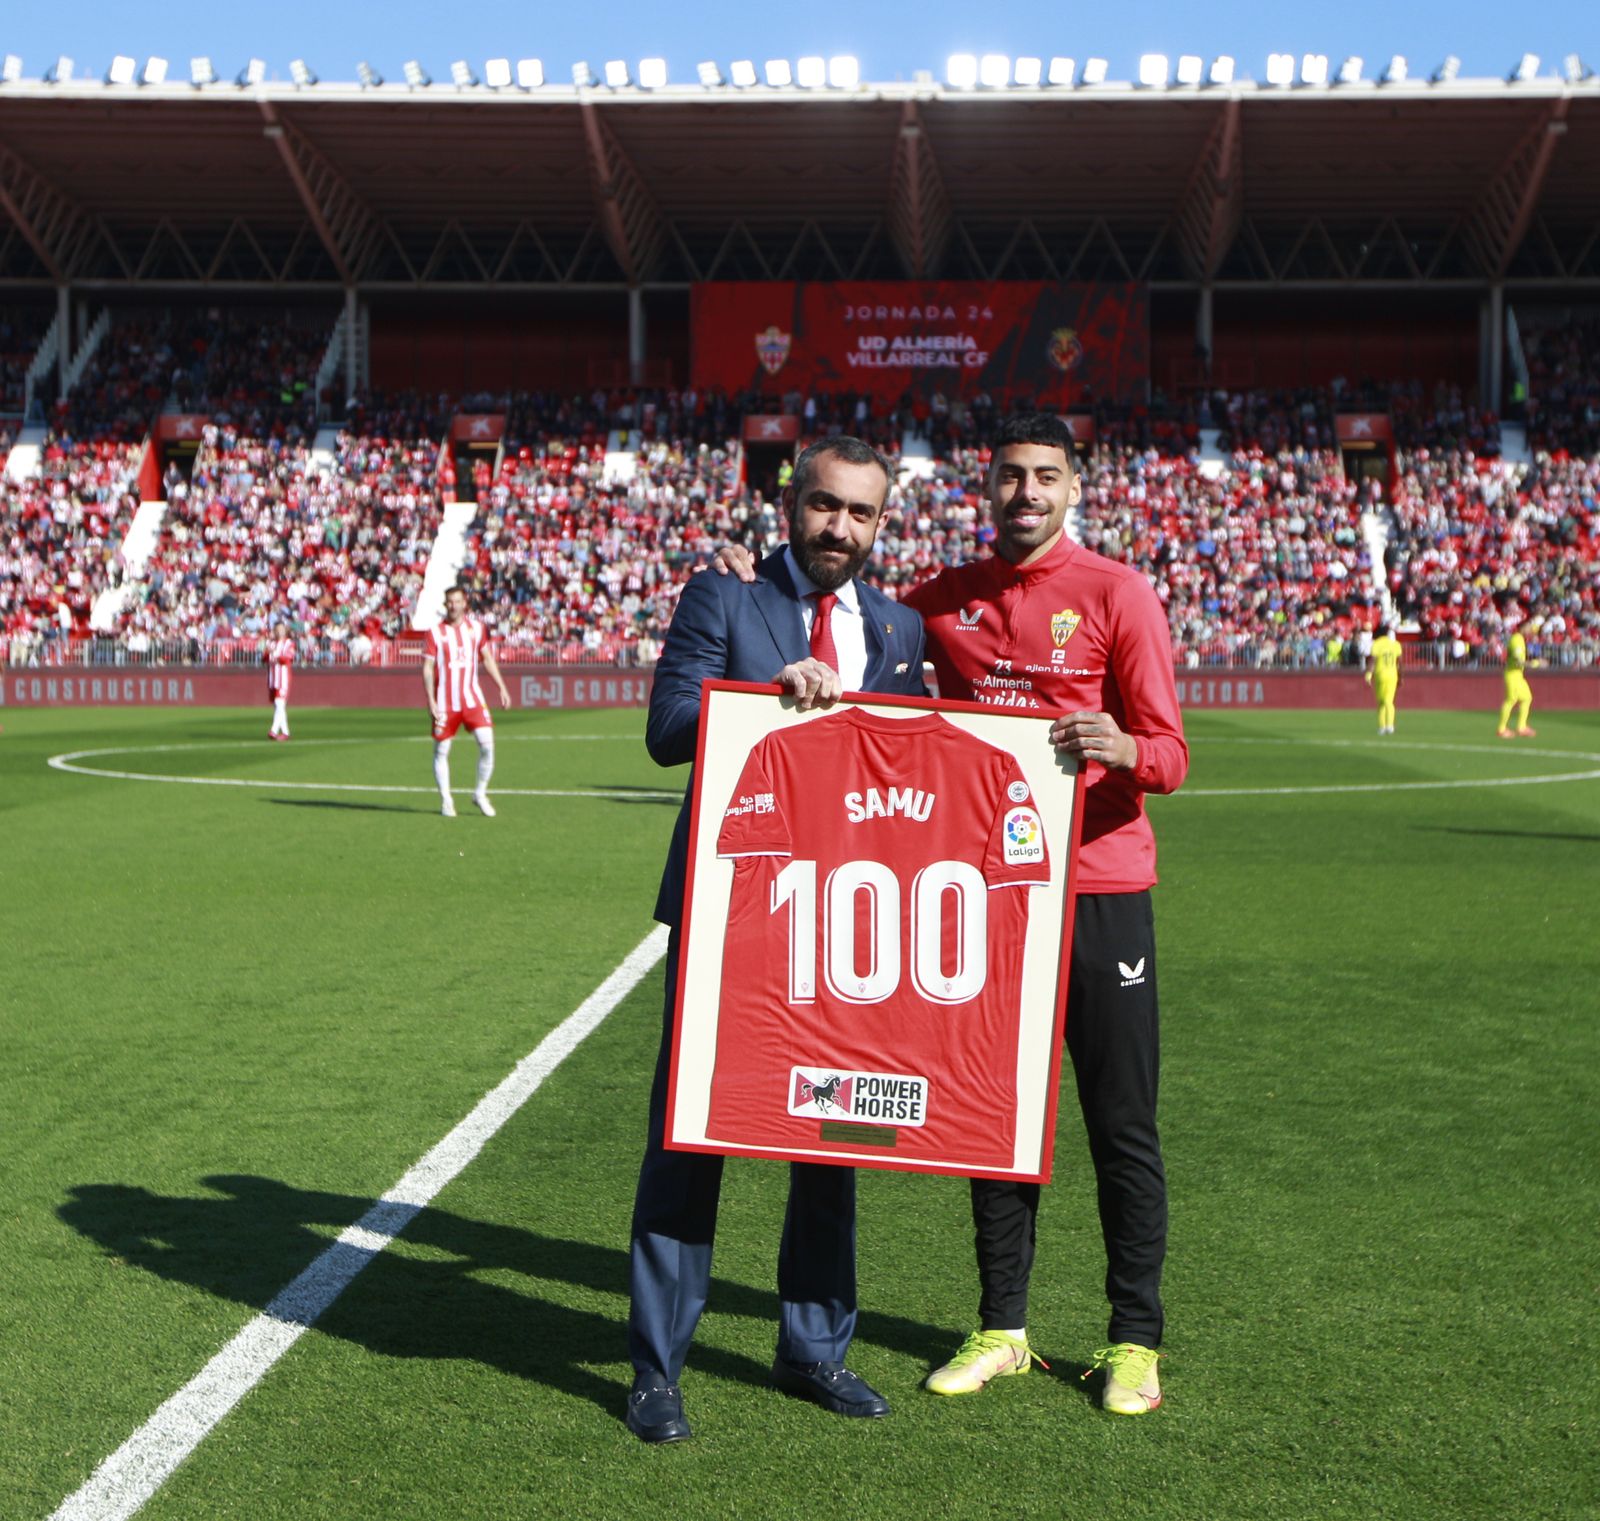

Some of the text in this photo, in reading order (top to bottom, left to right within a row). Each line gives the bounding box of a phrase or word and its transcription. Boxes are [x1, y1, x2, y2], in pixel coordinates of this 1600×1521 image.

[845, 305, 993, 320] JORNADA 24
[858, 332, 977, 350] UD ALMERÍA
[847, 351, 989, 368] VILLARREAL CF
[995, 659, 1012, 675] 23
[15, 678, 194, 701] CONSTRUCTORA
[983, 674, 1032, 690] Almería
[1176, 681, 1264, 703] UCTORA
[844, 787, 936, 823] SAMU
[1008, 847, 1040, 857] LaLiga
[770, 860, 988, 1005] 100
[855, 1077, 922, 1100] POWER
[854, 1097, 920, 1121] HORSE
